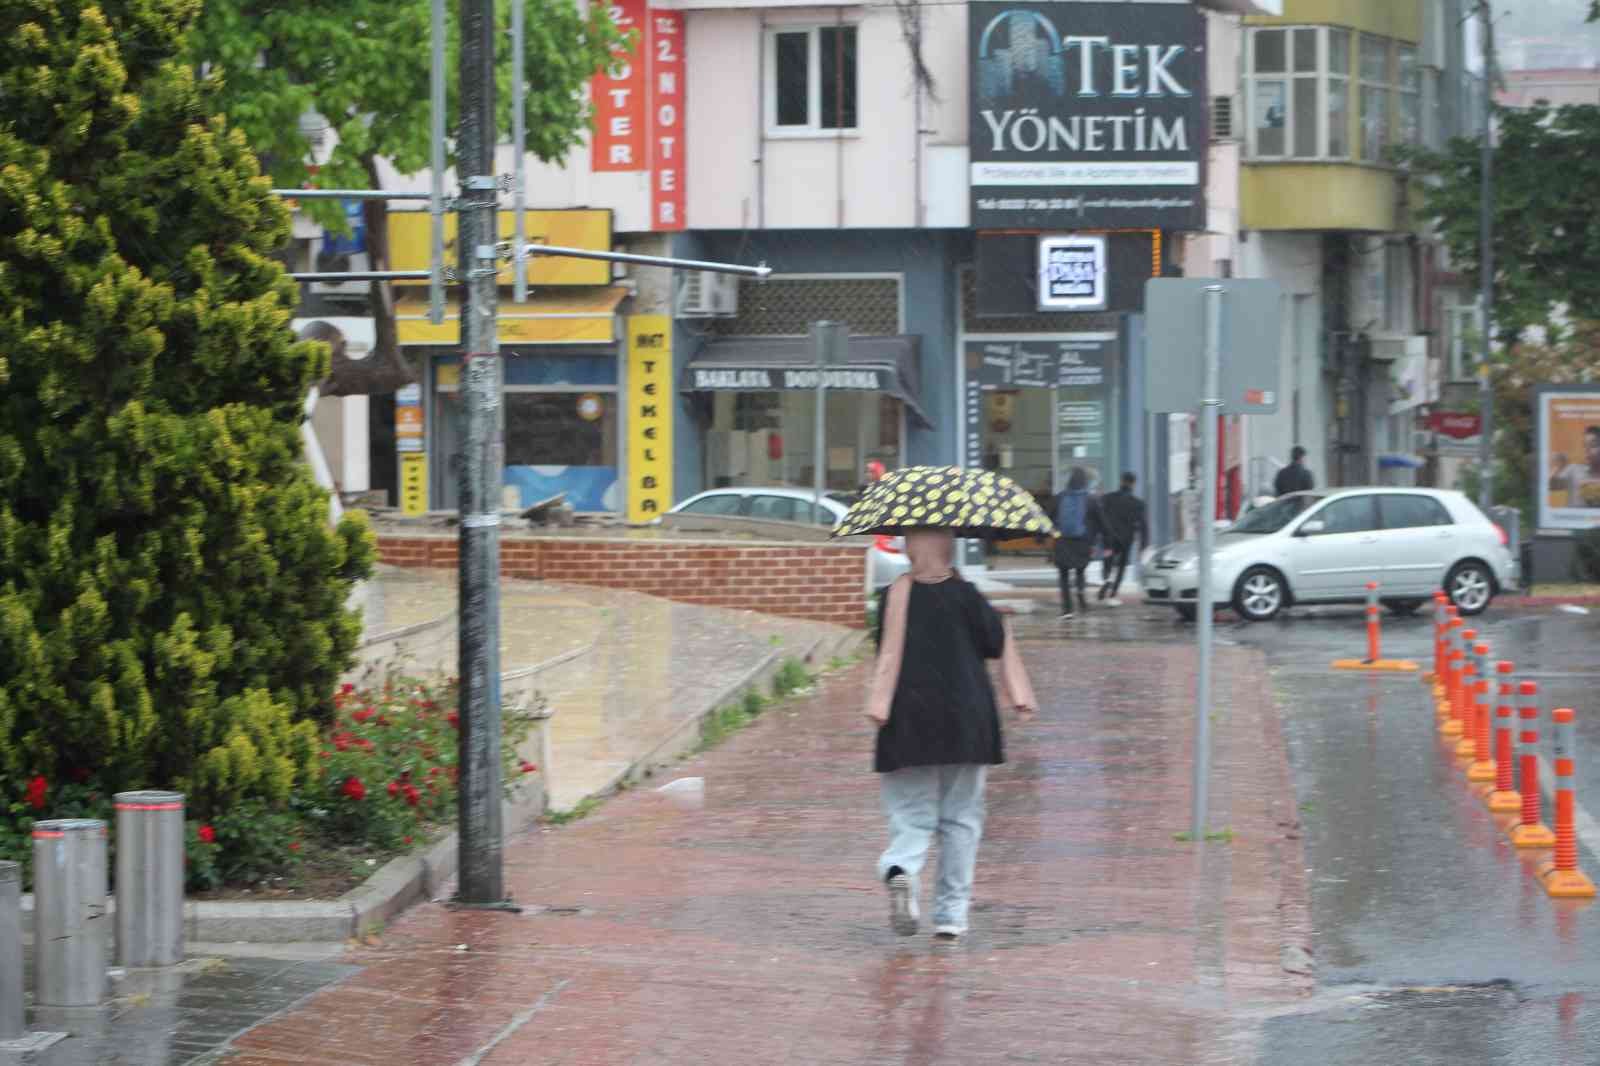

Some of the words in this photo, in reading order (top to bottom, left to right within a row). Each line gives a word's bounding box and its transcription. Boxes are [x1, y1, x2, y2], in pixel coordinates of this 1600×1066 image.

[1063, 36, 1192, 98] TEK
[657, 71, 677, 225] NOTER
[980, 108, 1189, 151] YÖNETİM
